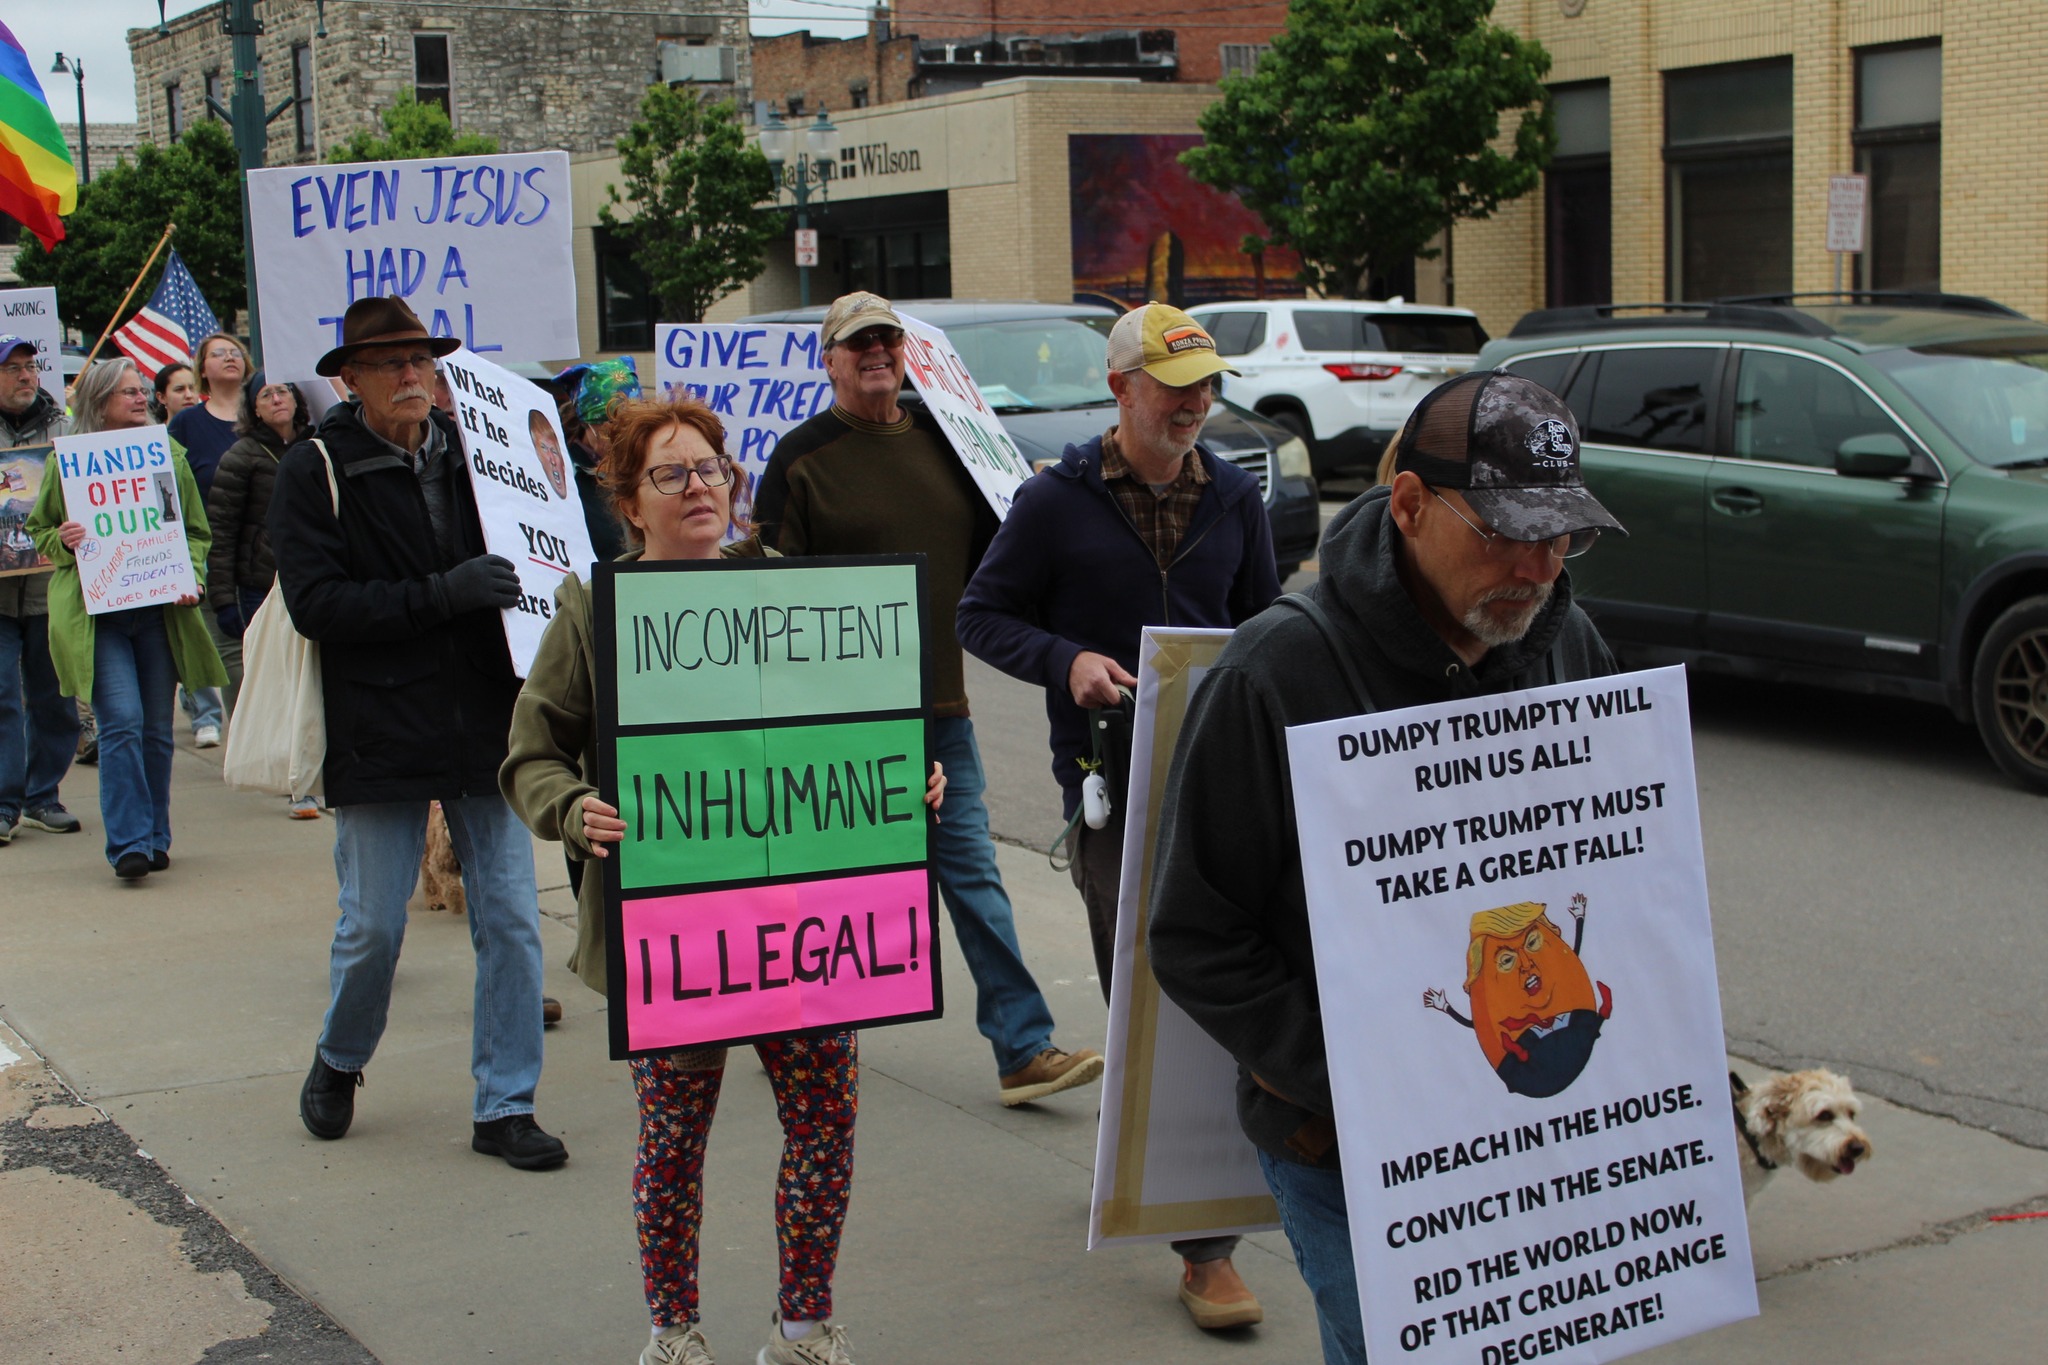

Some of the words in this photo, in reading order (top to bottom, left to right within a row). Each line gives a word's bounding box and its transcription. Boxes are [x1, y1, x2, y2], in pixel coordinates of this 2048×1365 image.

[859, 142, 921, 177] Wilson
[290, 169, 400, 238] EVEN
[414, 165, 551, 227] JESUS
[346, 247, 426, 305] HAD
[437, 246, 469, 295] A
[3, 300, 46, 317] WRONG
[318, 304, 503, 353] TAL
[664, 328, 769, 370] GIVE
[446, 362, 508, 411] What
[460, 402, 478, 433] if
[482, 411, 510, 448] he
[1547, 421, 1565, 433] Bass
[1551, 432, 1563, 442] Pro
[59, 441, 166, 478] HANDS
[473, 448, 549, 502] decides
[1542, 460, 1569, 468] CLUB
[88, 477, 146, 507] OFF
[94, 507, 162, 538] OUR
[136, 529, 179, 551] FAMILIES
[519, 522, 571, 568] YOU
[88, 540, 133, 604] NEIGHBORS
[126, 549, 173, 570] FRIENDS
[107, 592, 143, 607] LOVED
[150, 583, 177, 596] ONES
[516, 591, 552, 619] are
[632, 602, 909, 674] INCOMPETENT
[1337, 718, 1441, 762] DUMPY
[1447, 696, 1580, 743] TRUMPTY
[1586, 685, 1652, 719] WILL
[1414, 756, 1484, 793] RUIN
[1487, 748, 1526, 779] US
[1530, 735, 1592, 772] ALL!
[633, 754, 913, 842] INHUMANE
[1344, 822, 1448, 867] DUMPY
[1453, 797, 1586, 846] TRUMPTY
[1591, 782, 1666, 820] MUST
[1375, 865, 1449, 904] TAKE
[1455, 861, 1475, 890] A
[1479, 842, 1569, 884] GREAT
[1573, 825, 1645, 866] FALL!
[639, 906, 920, 1005] ILLEGAL!
[1381, 1130, 1511, 1189] IMPEACH
[1513, 1121, 1545, 1153] IN
[1548, 1107, 1599, 1143] THE
[1602, 1083, 1703, 1130] HOUSE.
[1385, 1190, 1512, 1249] CONVICT
[1516, 1181, 1548, 1214] IN
[1550, 1167, 1602, 1204] THE
[1606, 1138, 1714, 1188] SENATE.
[1413, 1267, 1463, 1304] RID
[1466, 1249, 1521, 1288] THE
[1523, 1220, 1626, 1271] WORLD
[1629, 1199, 1703, 1241] NOW,
[1399, 1317, 1438, 1353] OF
[1442, 1295, 1513, 1340] THAT
[1517, 1268, 1612, 1317] CRUAL
[1614, 1233, 1727, 1288] ORANGE
[1480, 1292, 1666, 1365] DEGENERATE!
